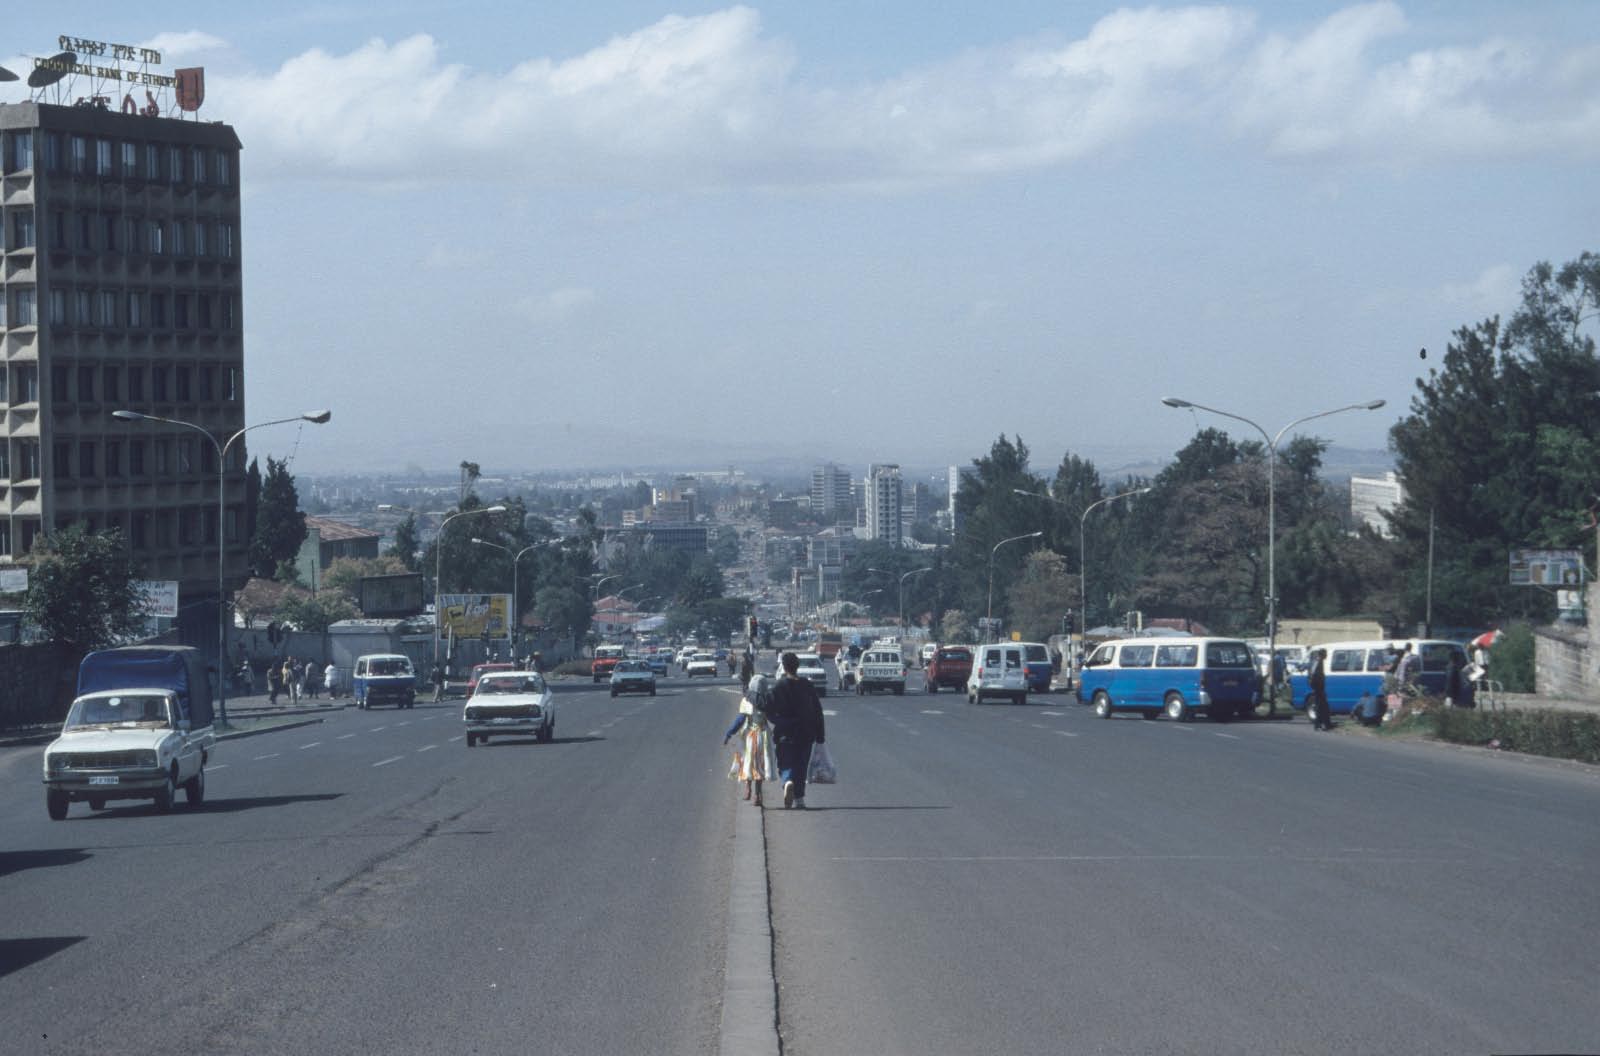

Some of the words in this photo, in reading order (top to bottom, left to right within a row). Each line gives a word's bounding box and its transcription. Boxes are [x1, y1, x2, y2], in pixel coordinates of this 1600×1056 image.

[97, 66, 122, 81] BANK
[127, 71, 139, 82] OF
[868, 668, 898, 676] TOYOTA
